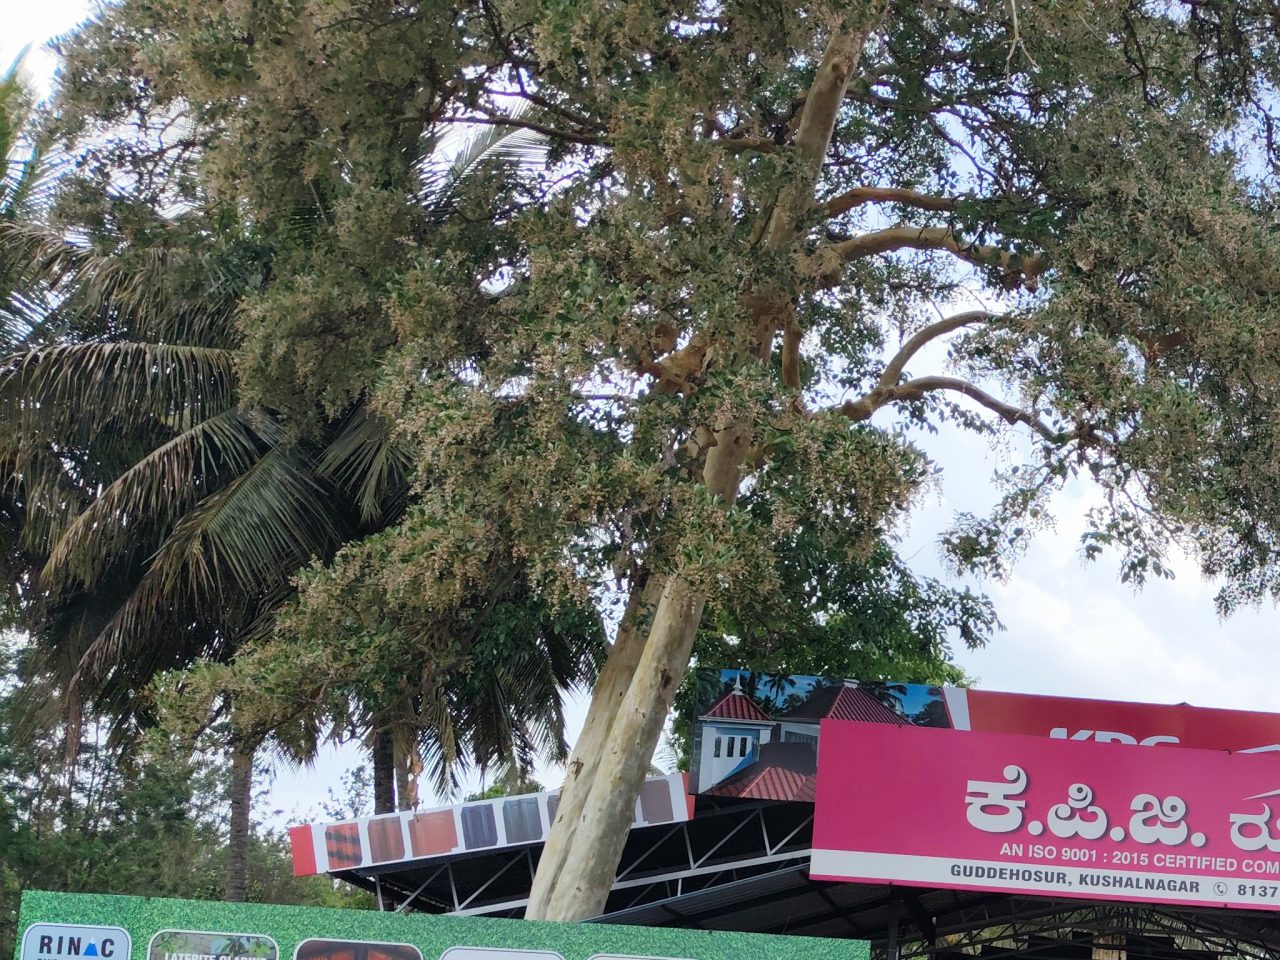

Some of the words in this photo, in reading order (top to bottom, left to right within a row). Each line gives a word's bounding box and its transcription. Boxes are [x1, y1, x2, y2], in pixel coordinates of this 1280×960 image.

[965, 764, 1206, 847] ಕೆ.ಪಿ.ಜಿ.
[1000, 844, 1023, 857] AN
[1028, 845, 1057, 859] ISO
[1061, 848, 1097, 862] 9001
[1112, 852, 1148, 866] 2015
[1154, 853, 1238, 872] CERTIFIED
[950, 864, 1073, 887] GUDDEHOSUR,
[1079, 873, 1200, 893] KUSHALNAGAR
[1237, 884, 1279, 898] 8137
